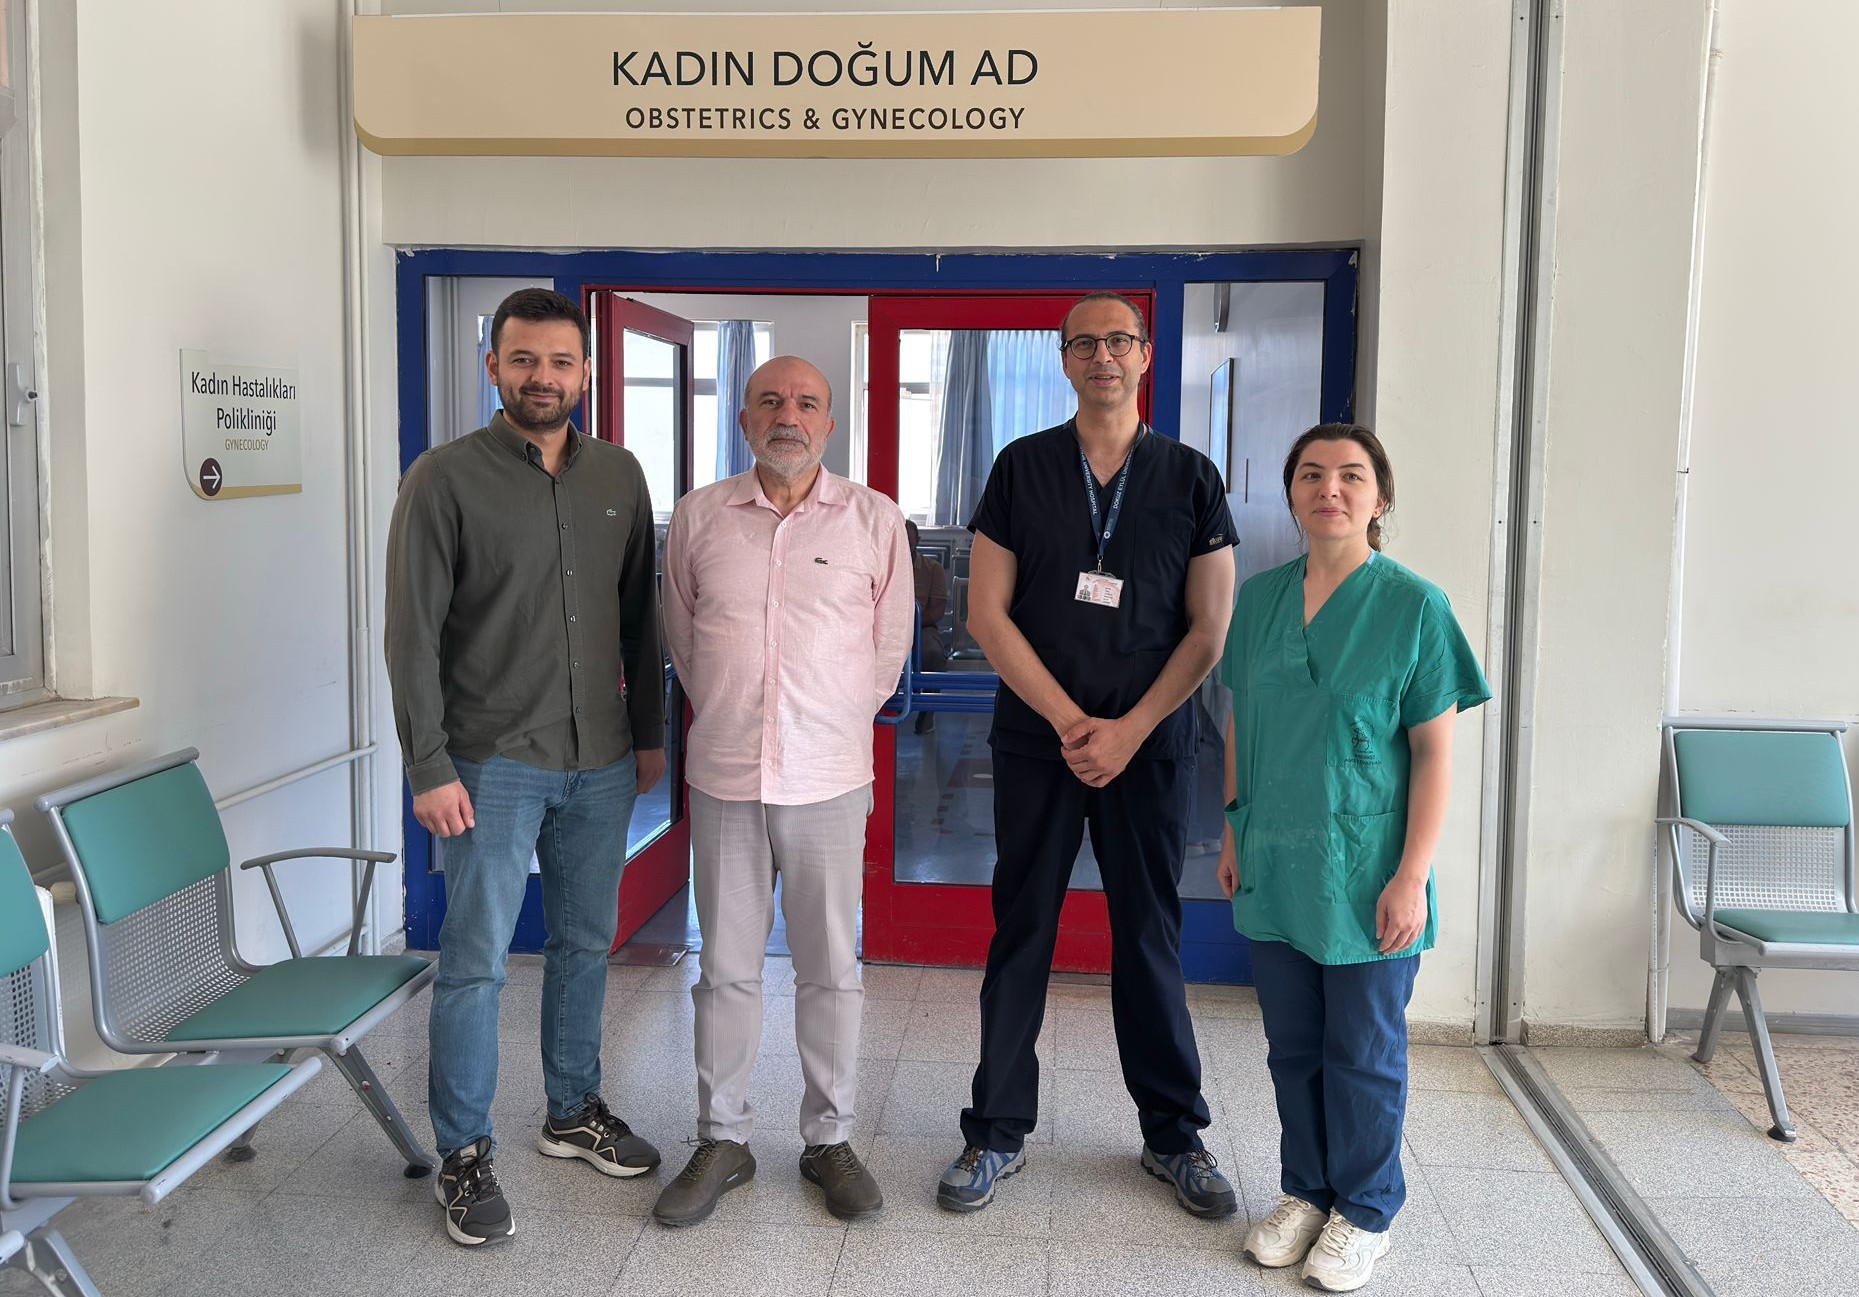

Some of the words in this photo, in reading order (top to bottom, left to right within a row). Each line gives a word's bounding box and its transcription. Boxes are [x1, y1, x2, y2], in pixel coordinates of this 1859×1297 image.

[613, 51, 754, 86] KADIN
[773, 41, 955, 86] DOĞUM
[970, 50, 1038, 86] AD
[626, 107, 791, 130] OBSTETRICS
[804, 108, 820, 130] &
[832, 107, 1024, 131] GYNECOLOGY
[191, 371, 229, 395] Kadın
[232, 375, 296, 400] Hastalıkları
[216, 407, 276, 436] Polikliniği
[224, 438, 269, 451] GYNECOLOGY
